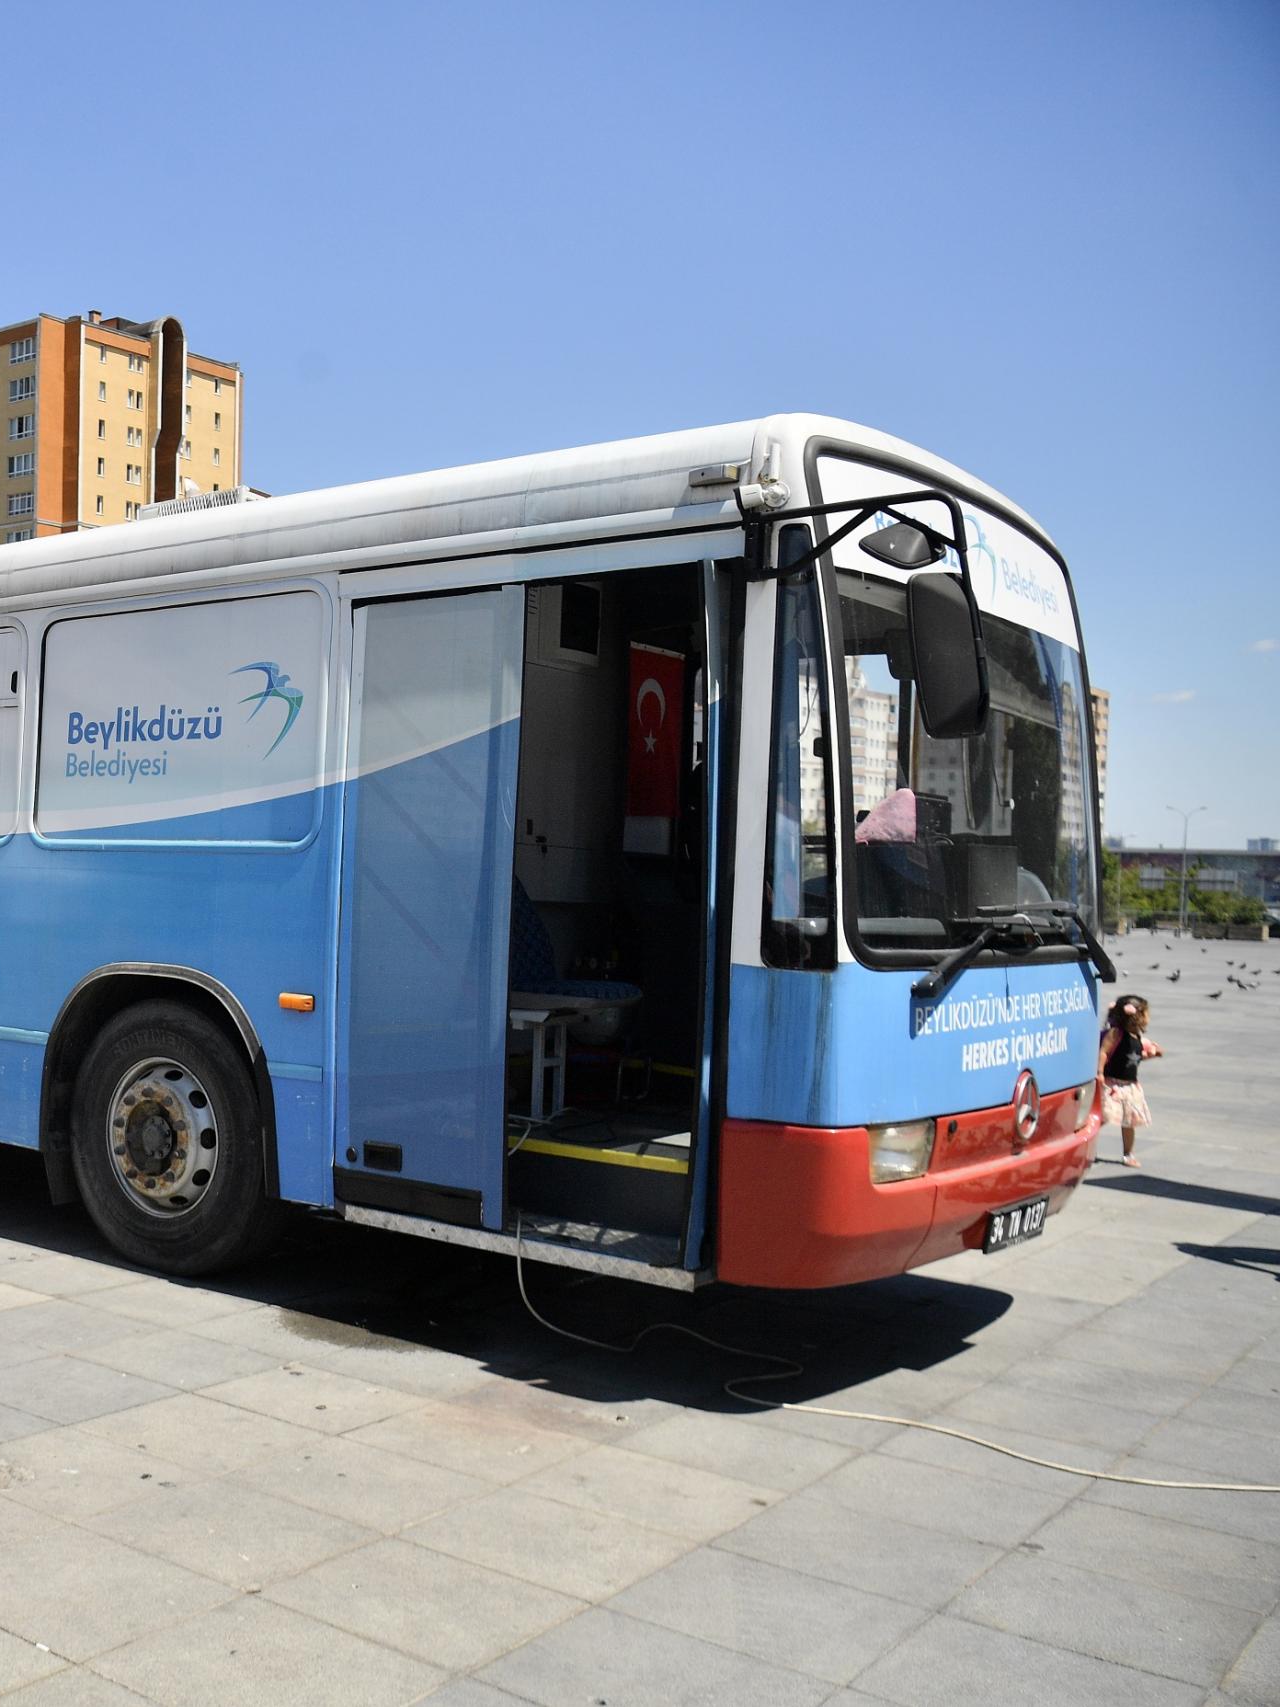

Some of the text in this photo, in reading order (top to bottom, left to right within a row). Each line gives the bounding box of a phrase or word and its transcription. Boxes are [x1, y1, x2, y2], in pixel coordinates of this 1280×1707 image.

[1001, 557, 1059, 617] Belediyesi
[67, 704, 223, 750] Beylikdüzü
[65, 750, 168, 784] Belediyesi
[1022, 992, 1041, 1020] HER
[1041, 988, 1063, 1016] YERE
[962, 1021, 1068, 1073] HERKES İÇİN SAĞLIK
[990, 1215, 1005, 1245] 34
[1023, 1201, 1046, 1233] 0137
